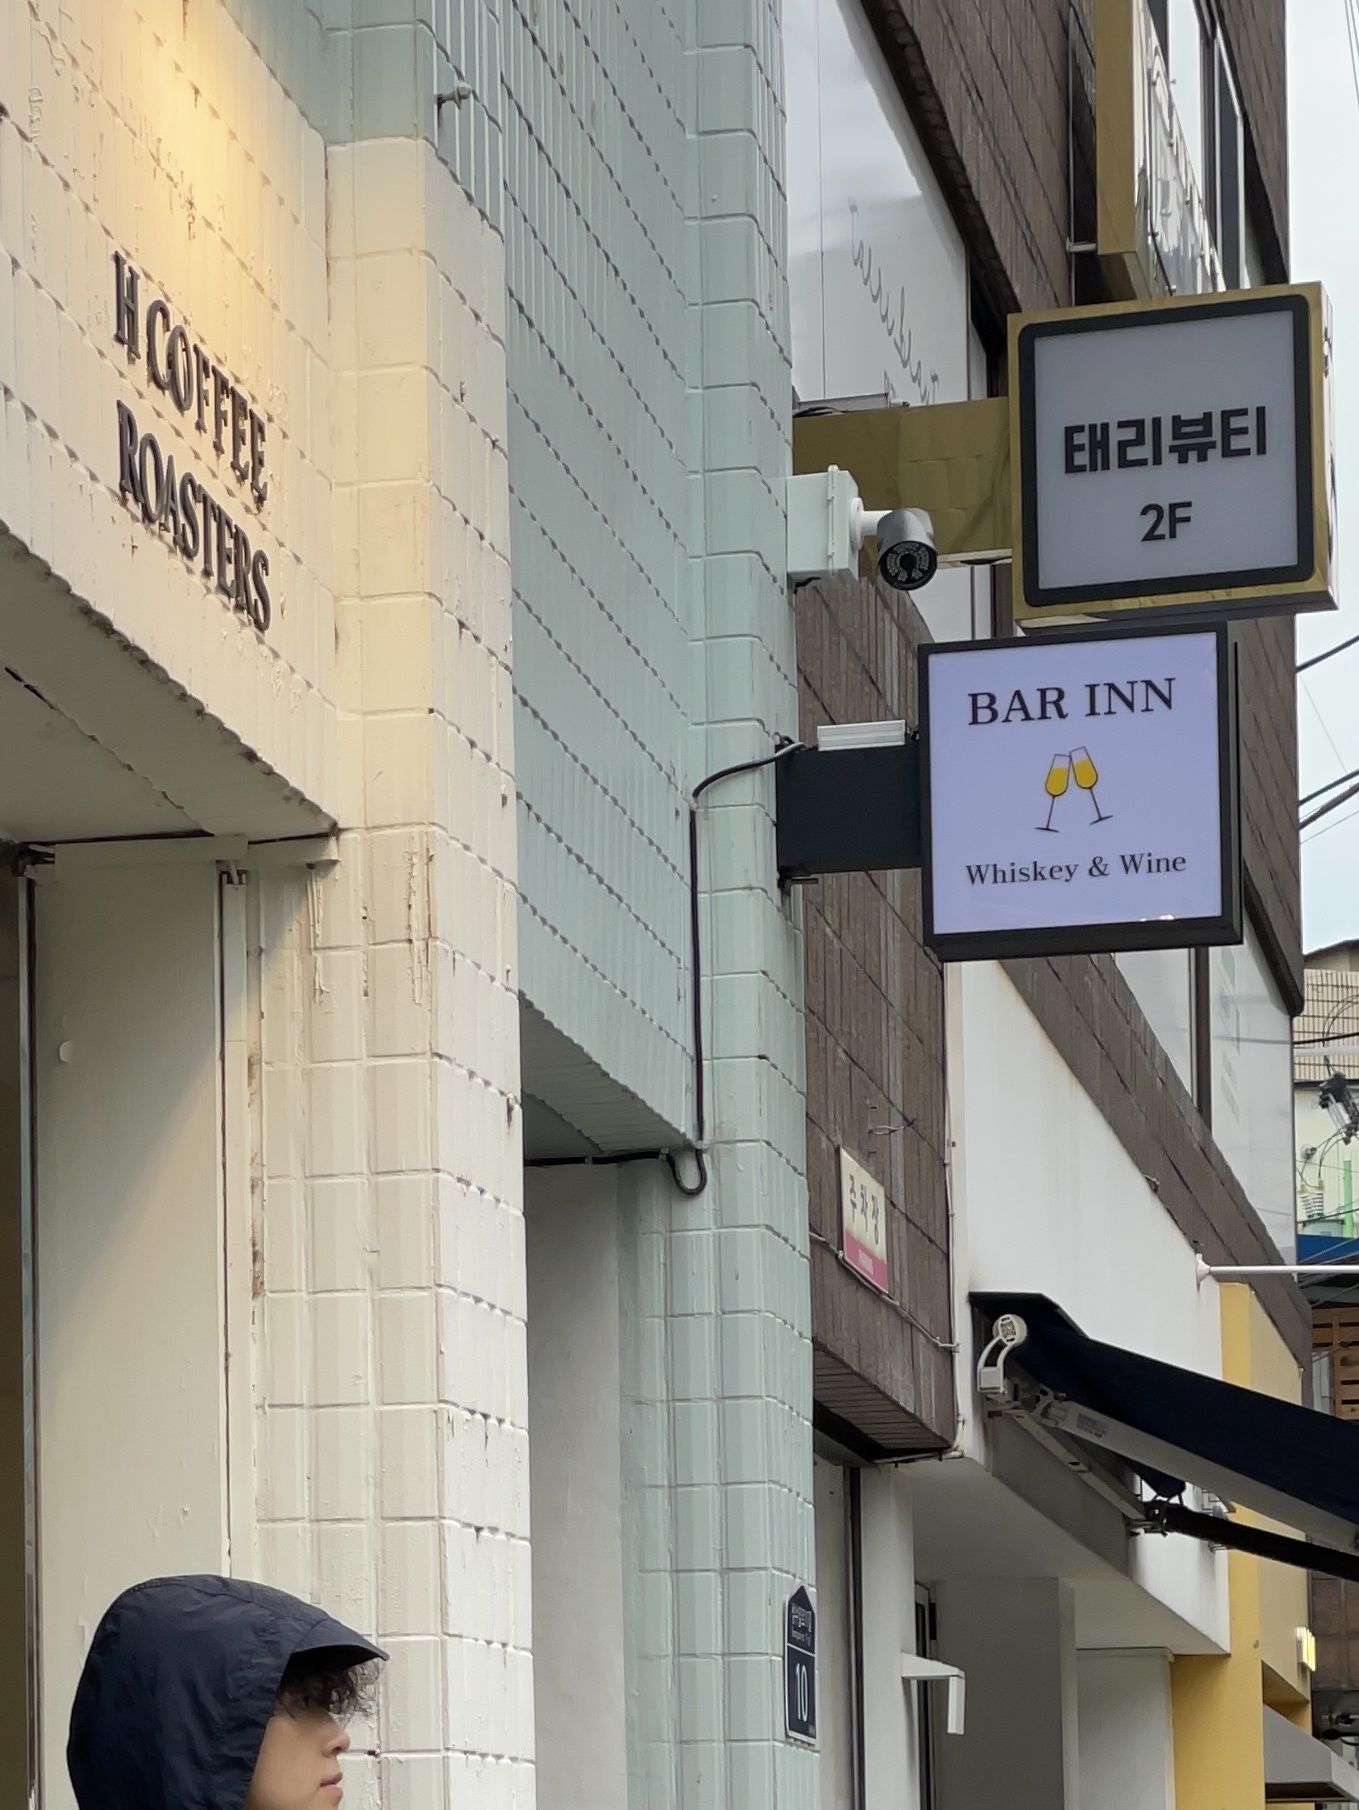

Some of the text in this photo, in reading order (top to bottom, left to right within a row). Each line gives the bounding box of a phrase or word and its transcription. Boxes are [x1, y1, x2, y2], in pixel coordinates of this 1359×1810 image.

[112, 249, 269, 503] H COFFEE
[1063, 405, 1268, 475] 태리뷰티
[116, 399, 271, 632] ROASTERS
[1140, 501, 1193, 543] 2F
[968, 677, 1177, 727] BAR INN
[965, 851, 1187, 887] Whiskey & Wine
[848, 1173, 880, 1246] 주차장
[795, 1662, 809, 1723] 10
